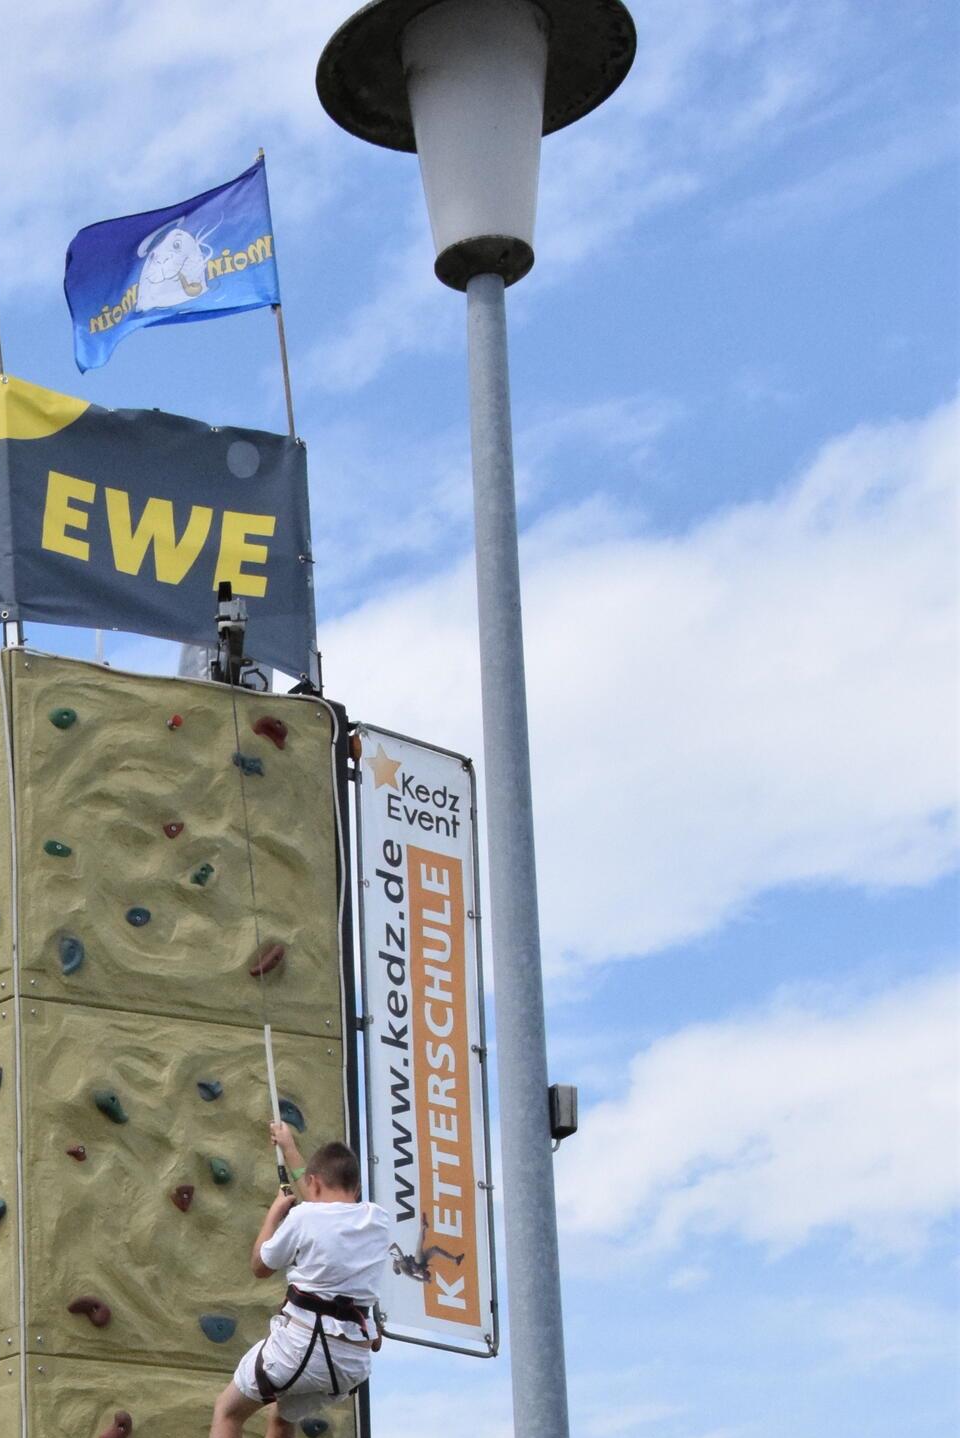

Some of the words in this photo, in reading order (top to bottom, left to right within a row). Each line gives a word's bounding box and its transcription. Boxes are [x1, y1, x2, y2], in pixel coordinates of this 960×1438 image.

[41, 470, 277, 598] EWE
[387, 793, 460, 838] Event
[402, 772, 460, 813] Kedz
[376, 838, 416, 1222] www.kedz.de
